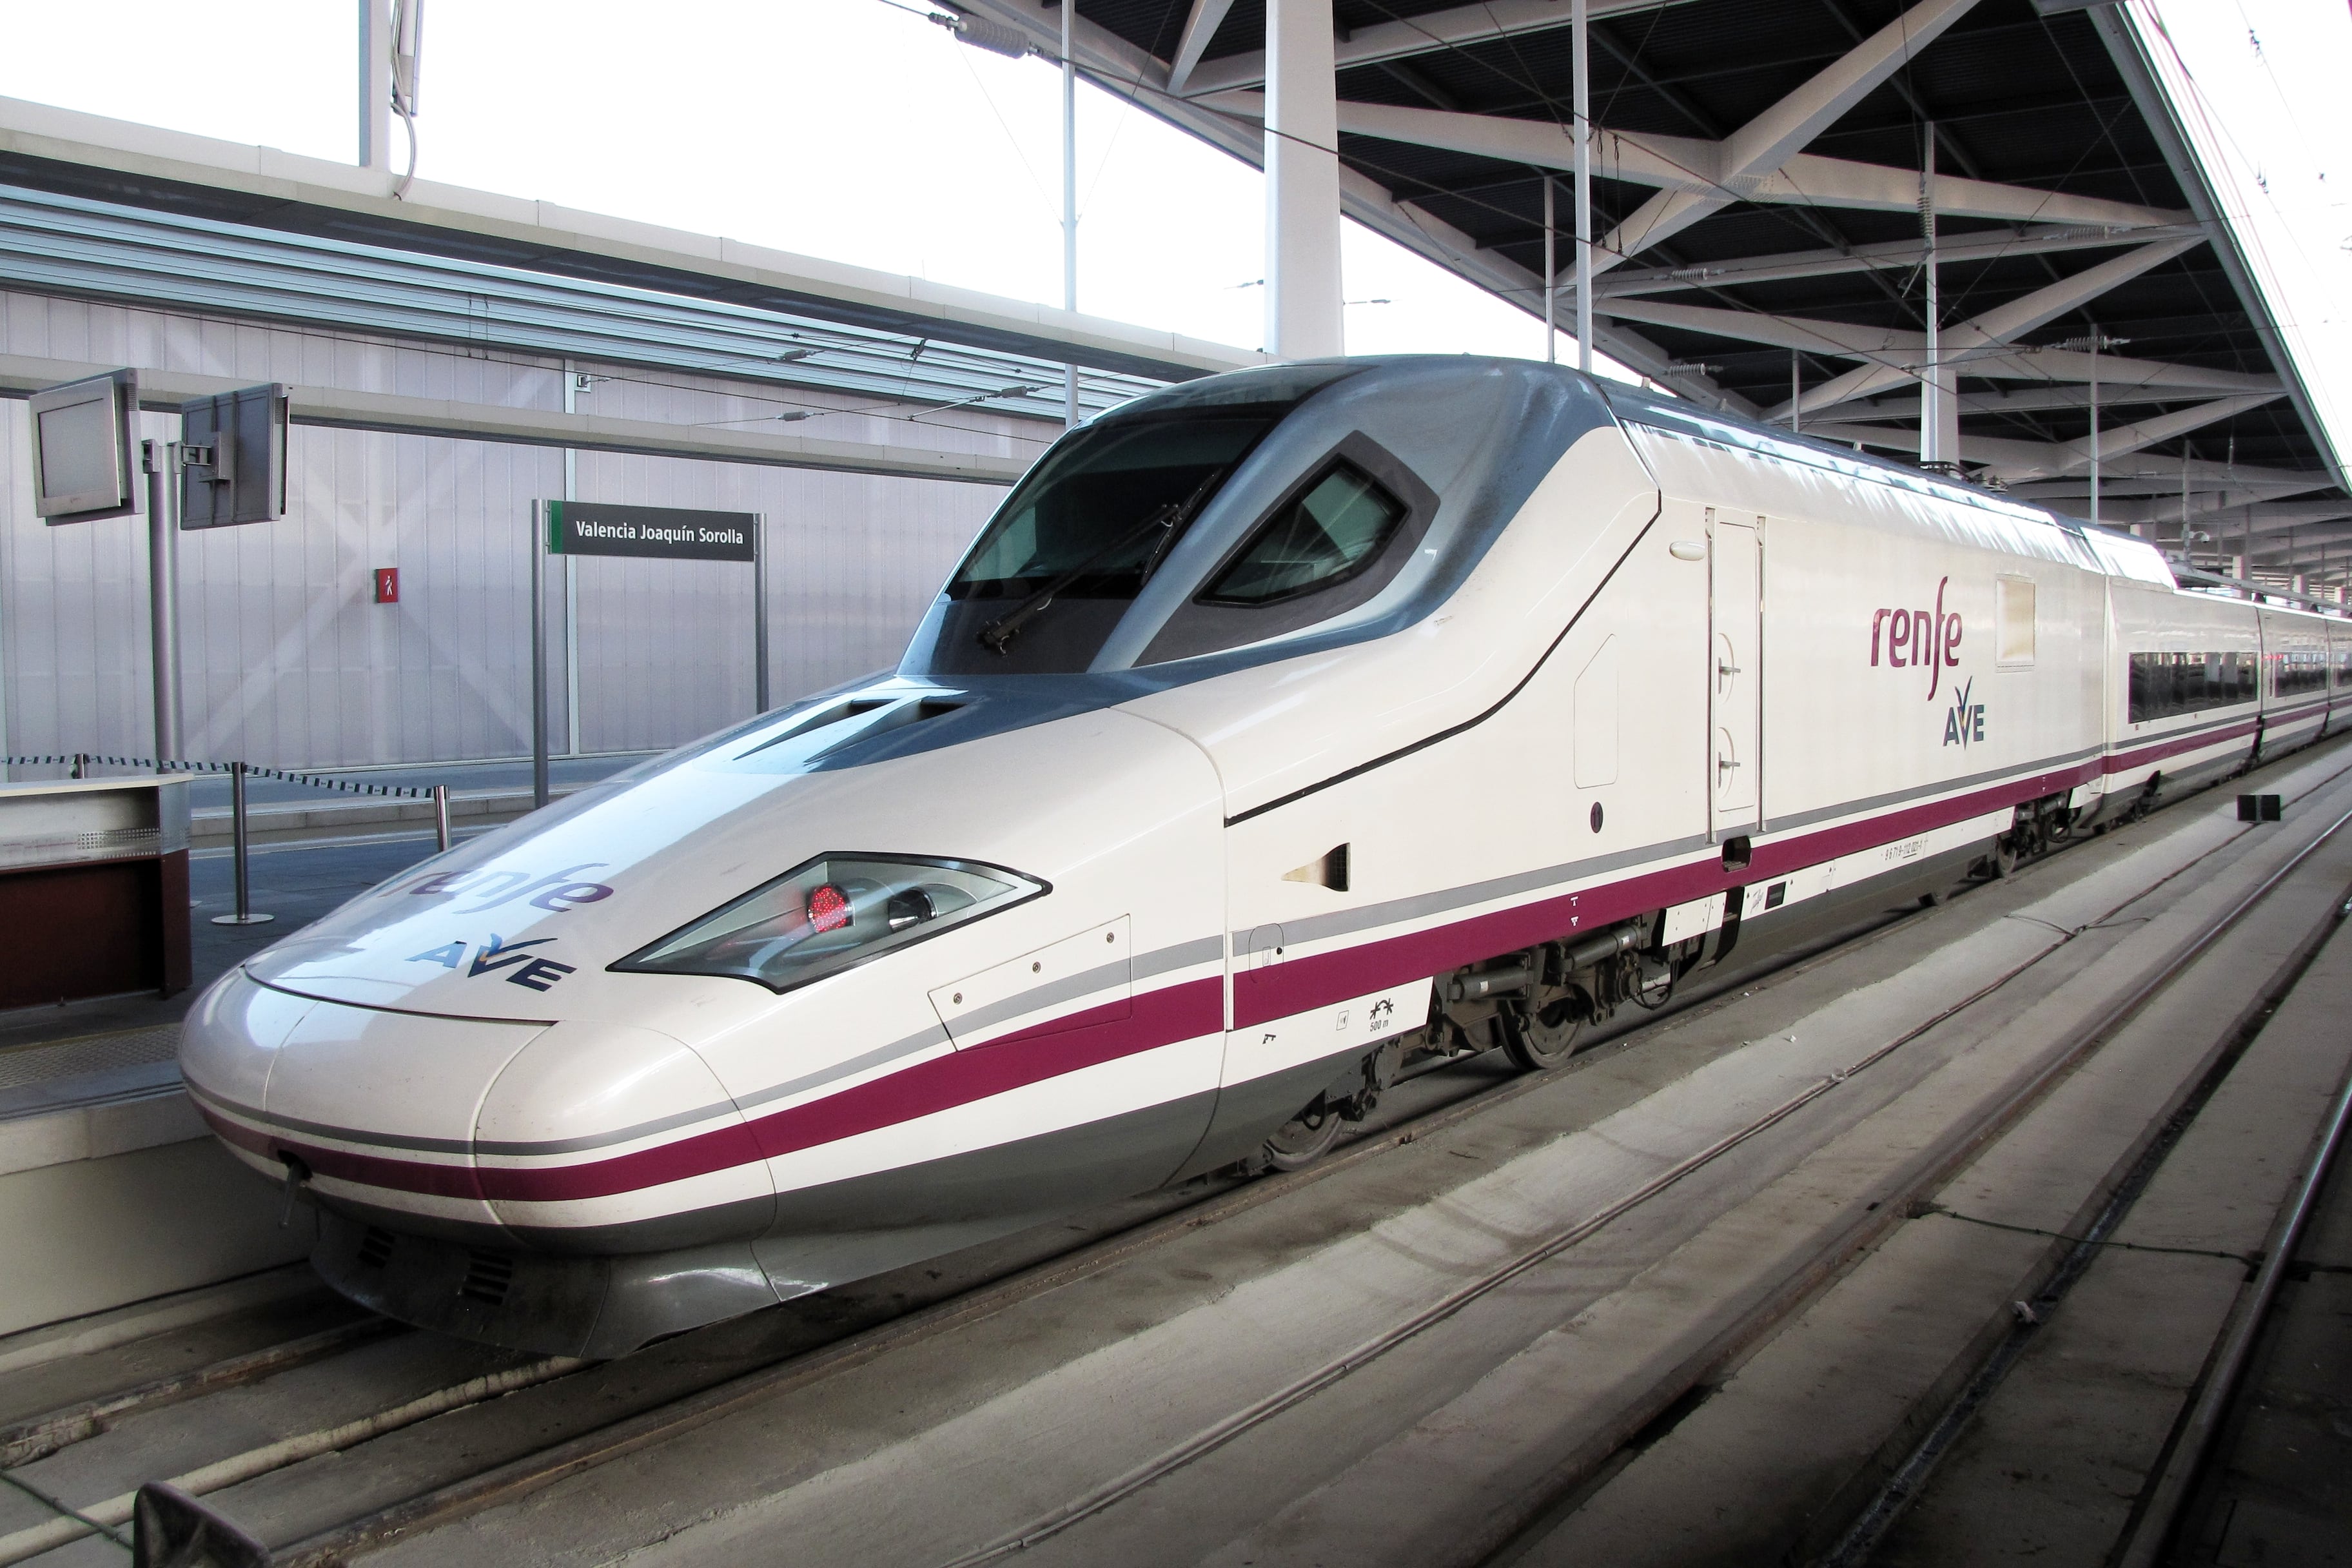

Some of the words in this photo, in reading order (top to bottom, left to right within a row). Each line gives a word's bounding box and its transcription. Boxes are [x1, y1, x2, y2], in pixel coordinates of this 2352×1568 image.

[576, 520, 636, 539] Valencia
[640, 524, 695, 544] Joaquín
[699, 527, 744, 544] Sorolla
[1870, 576, 1963, 701] renfe
[1943, 675, 1985, 751] AVE
[377, 863, 614, 915] renfe
[404, 932, 578, 992] AVE
[1369, 1019, 1382, 1032] 500
[1382, 1019, 1389, 1028] m
